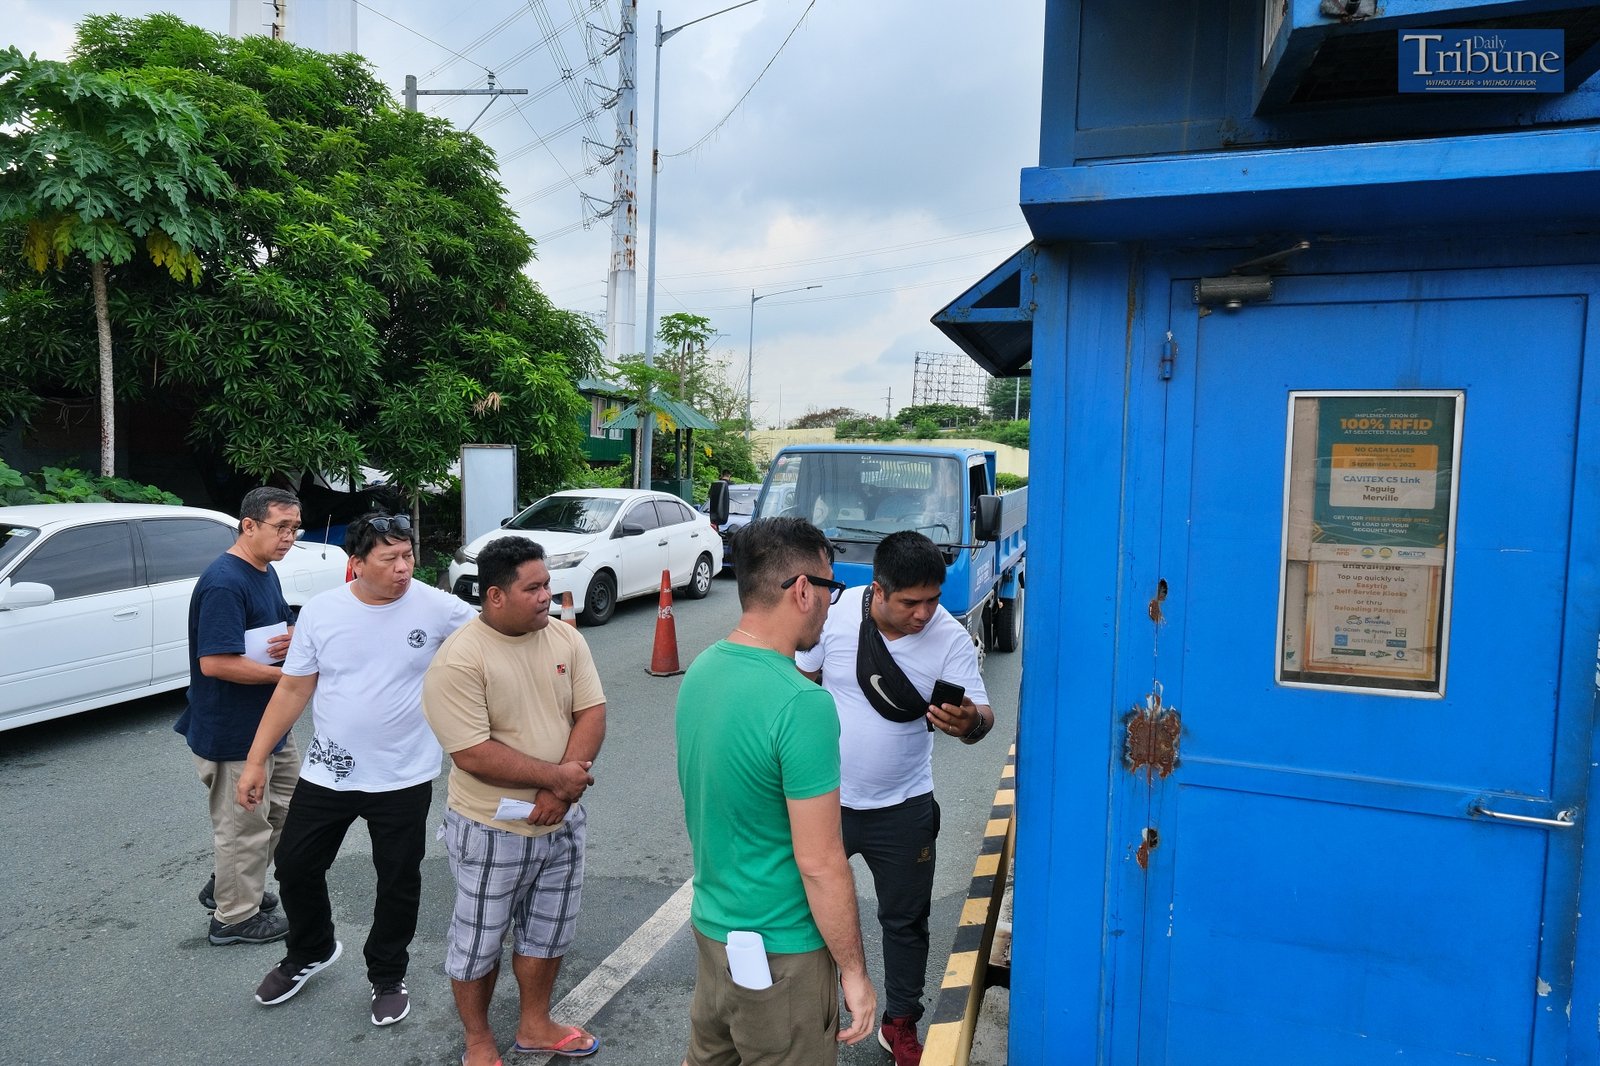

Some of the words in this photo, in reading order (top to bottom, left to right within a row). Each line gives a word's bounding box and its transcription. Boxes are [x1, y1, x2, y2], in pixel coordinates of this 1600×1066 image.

[1341, 418, 1384, 429] 100%
[1389, 418, 1432, 430] RFID
[1343, 475, 1385, 483] CAVITEX
[1386, 475, 1398, 484] C5
[1400, 476, 1421, 484] Link
[1364, 485, 1396, 494] Taguig
[1362, 494, 1399, 502] Merville
[1364, 574, 1392, 582] quickly
[1356, 582, 1388, 590] Easytrip
[1334, 605, 1372, 613] Reloading
